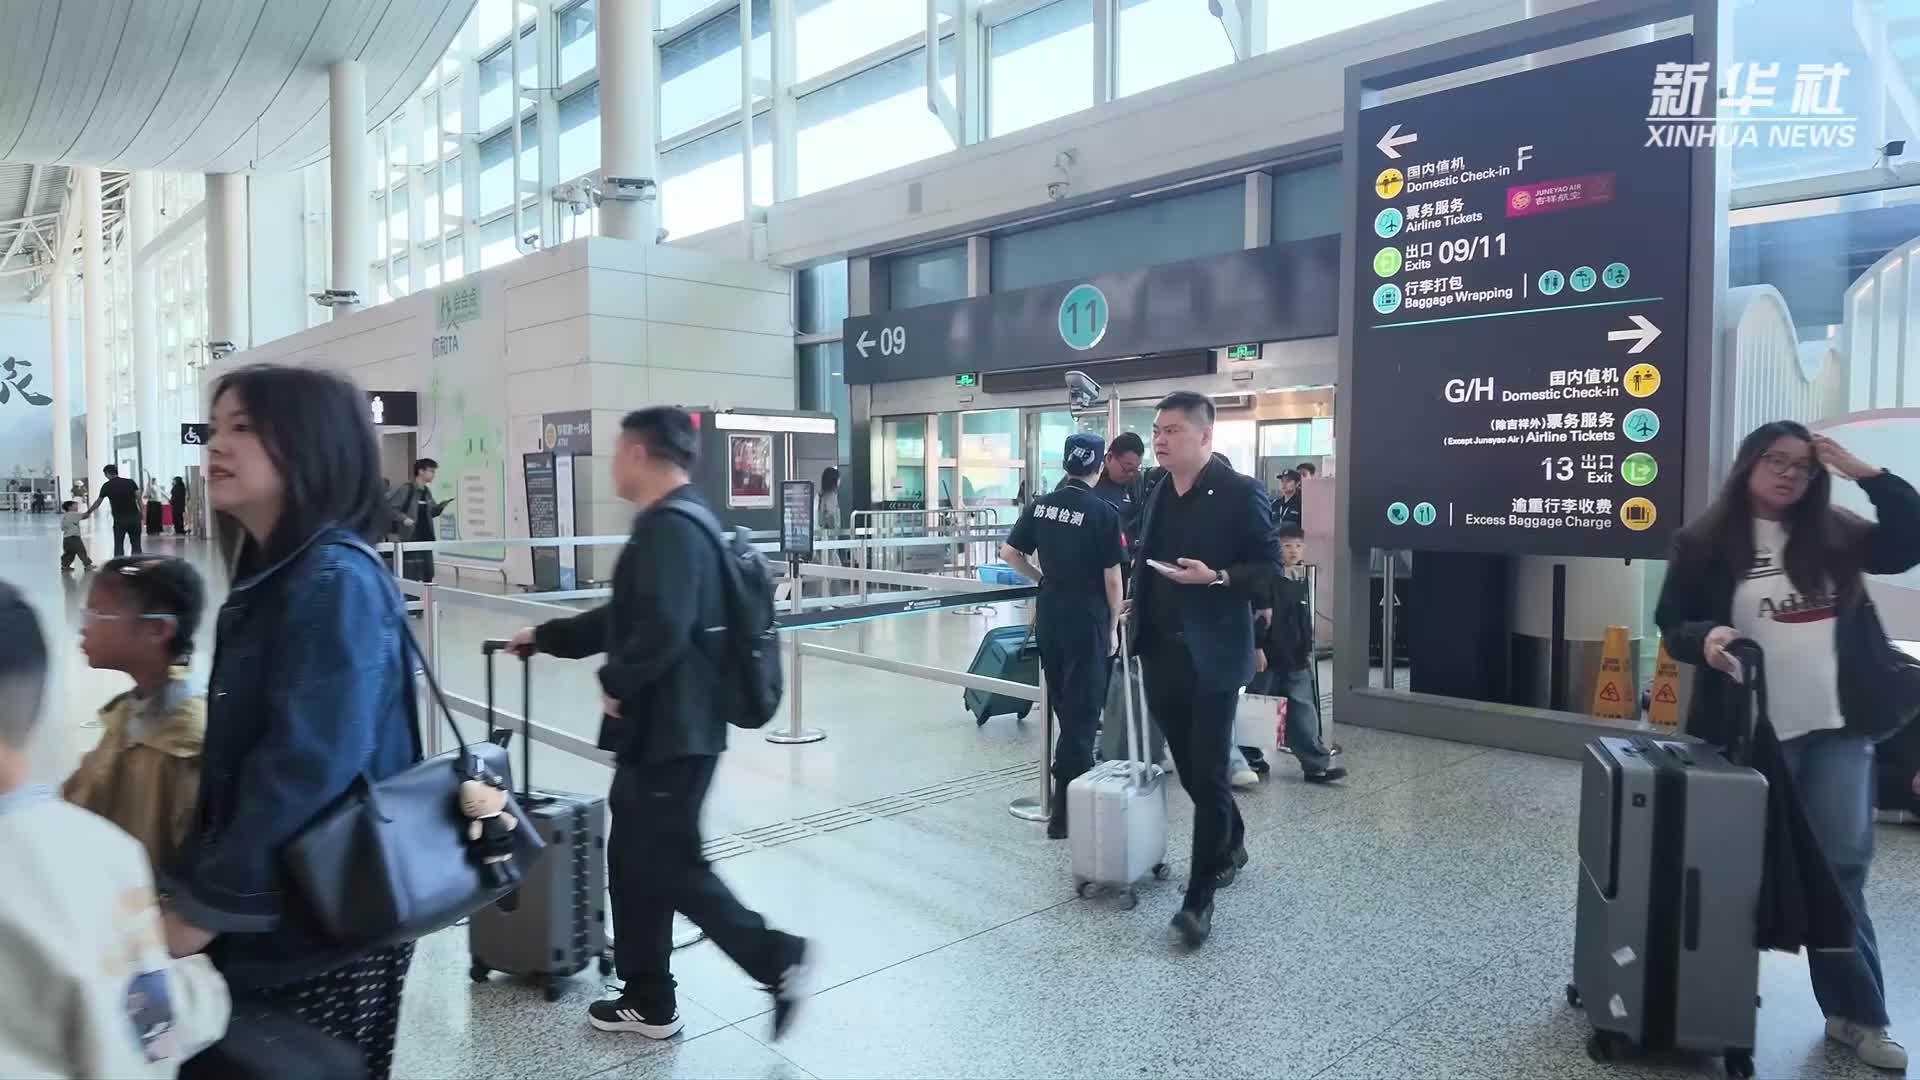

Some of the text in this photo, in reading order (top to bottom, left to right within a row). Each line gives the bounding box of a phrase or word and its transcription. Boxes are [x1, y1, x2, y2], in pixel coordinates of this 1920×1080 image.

[1407, 157, 1465, 179] 国内值机
[1517, 145, 1534, 171] F
[1407, 166, 1510, 193] Domestic Check-in
[1535, 186, 1568, 197] JUNEYAO
[1406, 198, 1464, 220] 票务服务
[1405, 212, 1483, 233] Airline Tickets
[1405, 242, 1433, 259] 出口
[1439, 232, 1506, 264] 09/11
[1405, 259, 1431, 272] Exits
[1405, 276, 1463, 297] 行李打包
[1405, 287, 1513, 309] Baggage Wrapping
[1066, 299, 1098, 335] 11
[880, 326, 906, 356] 09
[1549, 368, 1619, 387] 国内值机
[1444, 377, 1494, 403] G/H
[1502, 386, 1619, 402] Domestic Check-in
[1526, 431, 1568, 443] Airline
[1569, 429, 1616, 442] Tickets
[1541, 456, 1574, 481] 13
[1581, 454, 1614, 470] 出口
[1587, 471, 1613, 484] Exit
[1033, 504, 1085, 526] 防爆检测
[1511, 497, 1613, 514] 逾重行李收费
[1465, 514, 1612, 530] Excess Baggage Charge
